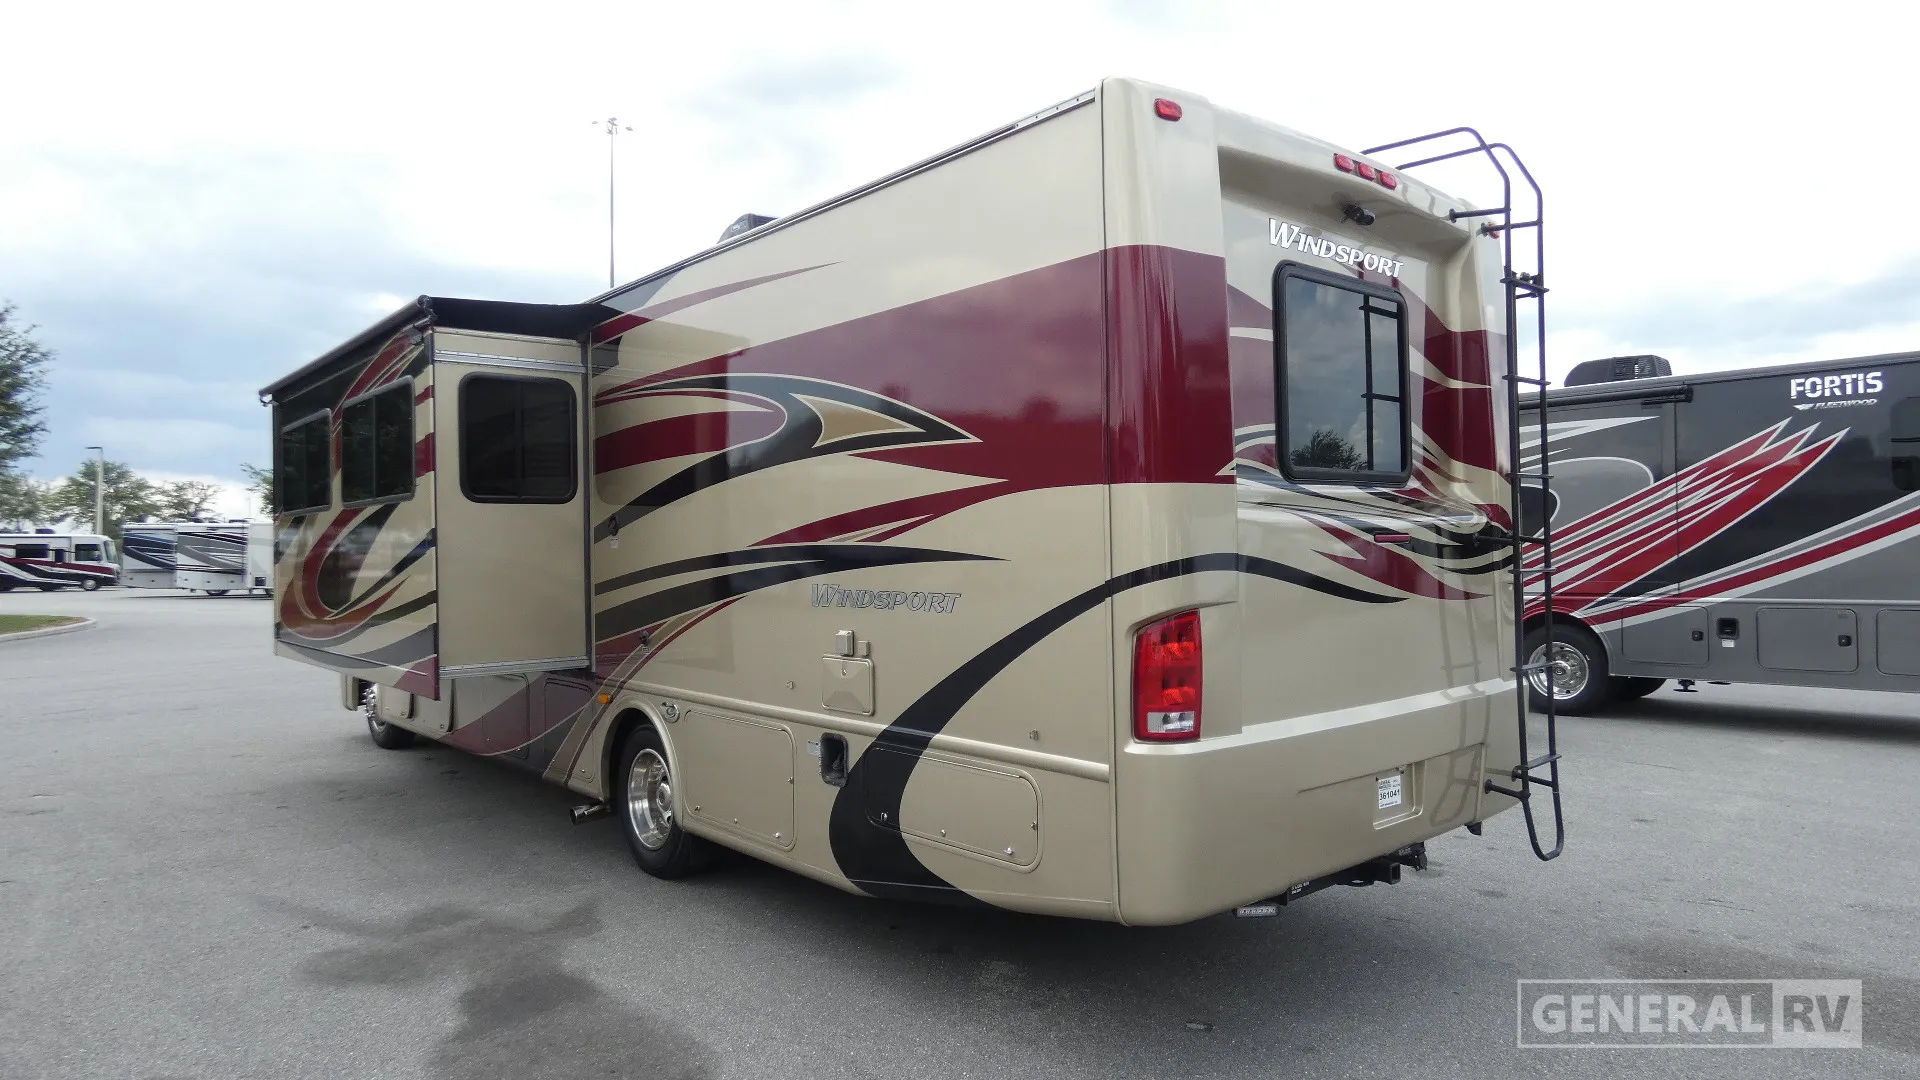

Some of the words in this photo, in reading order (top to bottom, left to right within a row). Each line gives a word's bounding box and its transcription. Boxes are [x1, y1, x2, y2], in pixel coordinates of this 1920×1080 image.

[1268, 217, 1404, 278] WINDSPORT
[1790, 371, 1884, 399] FORTIS
[1814, 398, 1878, 410] FLEETWOOD
[811, 583, 962, 614] WINDSPORT
[1379, 789, 1400, 801] 361041
